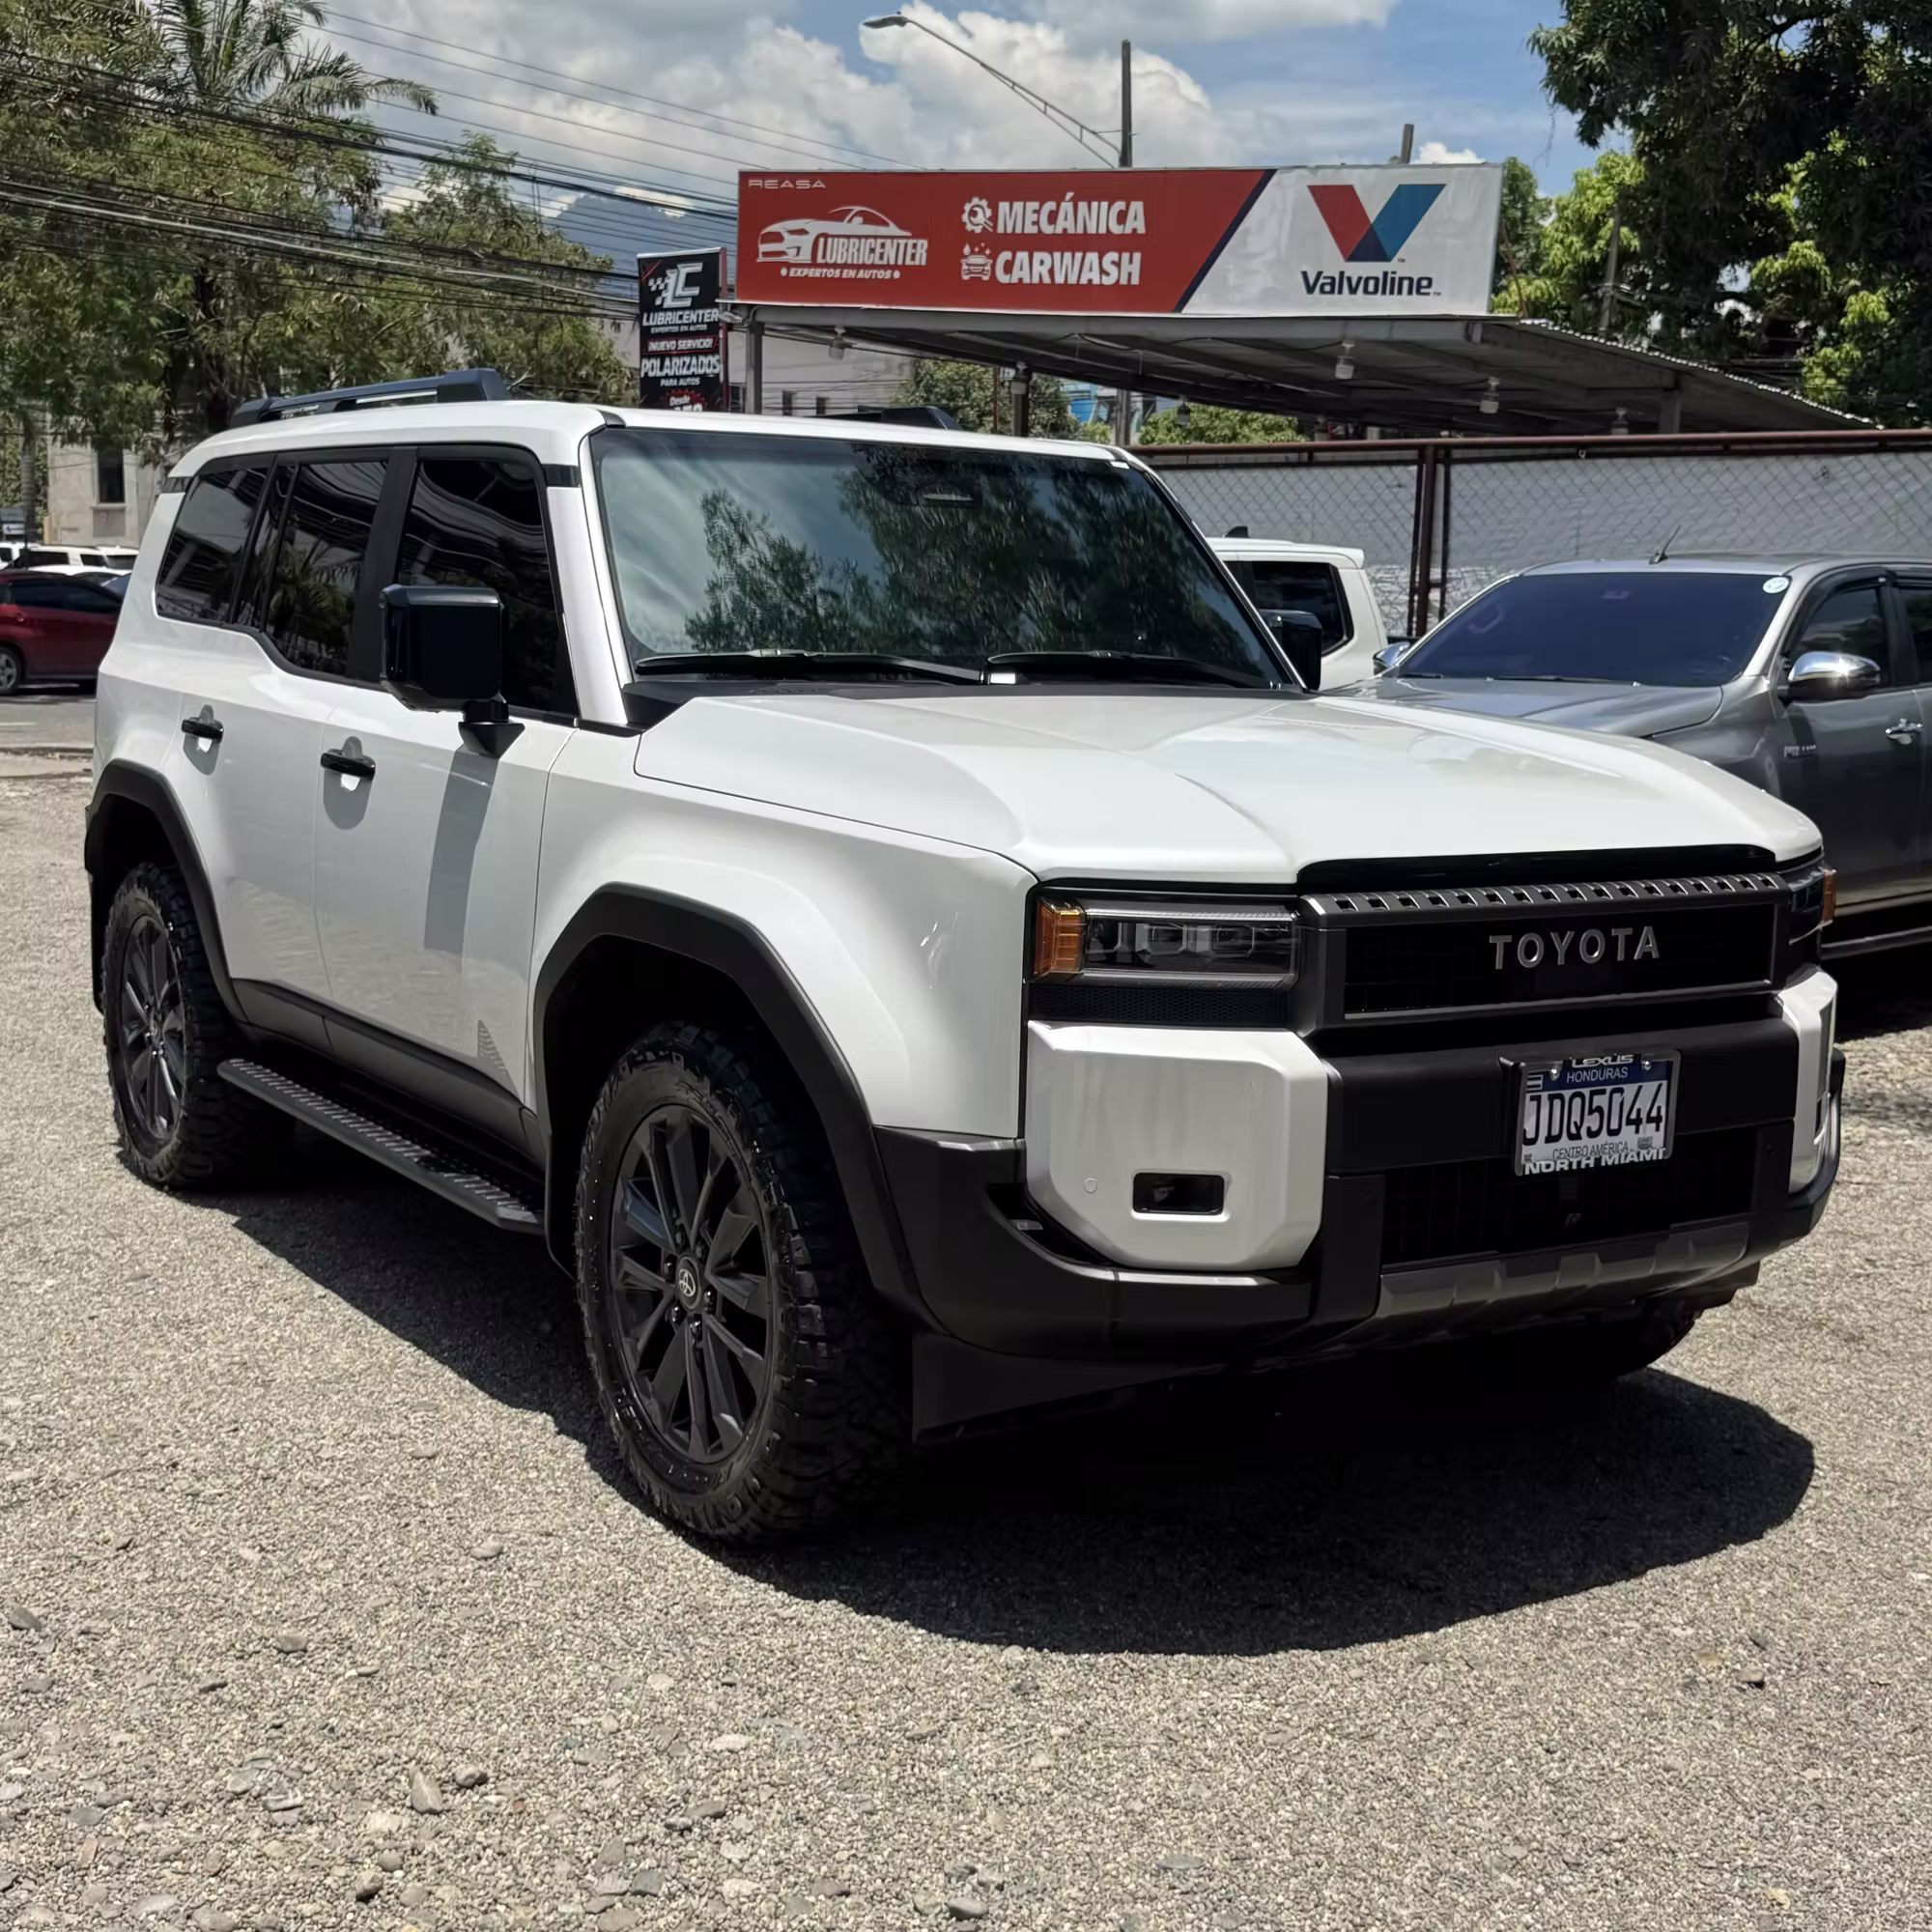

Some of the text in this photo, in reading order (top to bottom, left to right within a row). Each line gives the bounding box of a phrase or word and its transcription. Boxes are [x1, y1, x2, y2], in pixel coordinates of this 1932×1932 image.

[748, 179, 827, 189] REASA
[996, 191, 1147, 235] MECÁNICA
[816, 237, 928, 266] LUBRICENTER
[788, 268, 892, 279] EXPERTOS EN AUTOS
[995, 250, 1142, 285] CARWASH
[1300, 270, 1434, 297] Valvoline
[641, 308, 720, 327] LUBRICENTER
[640, 355, 721, 378] POLARIZADOS
[660, 377, 700, 386] PARA AUTOS
[1489, 925, 1660, 970] TOYOTA
[1572, 1054, 1634, 1068] LEXUS
[1566, 1066, 1629, 1084] HONDURAS
[1522, 1082, 1664, 1146] JDQ5044
[1524, 1147, 1666, 1176] NORTH MIAMI
[1552, 1145, 1589, 1160] CENTRO
